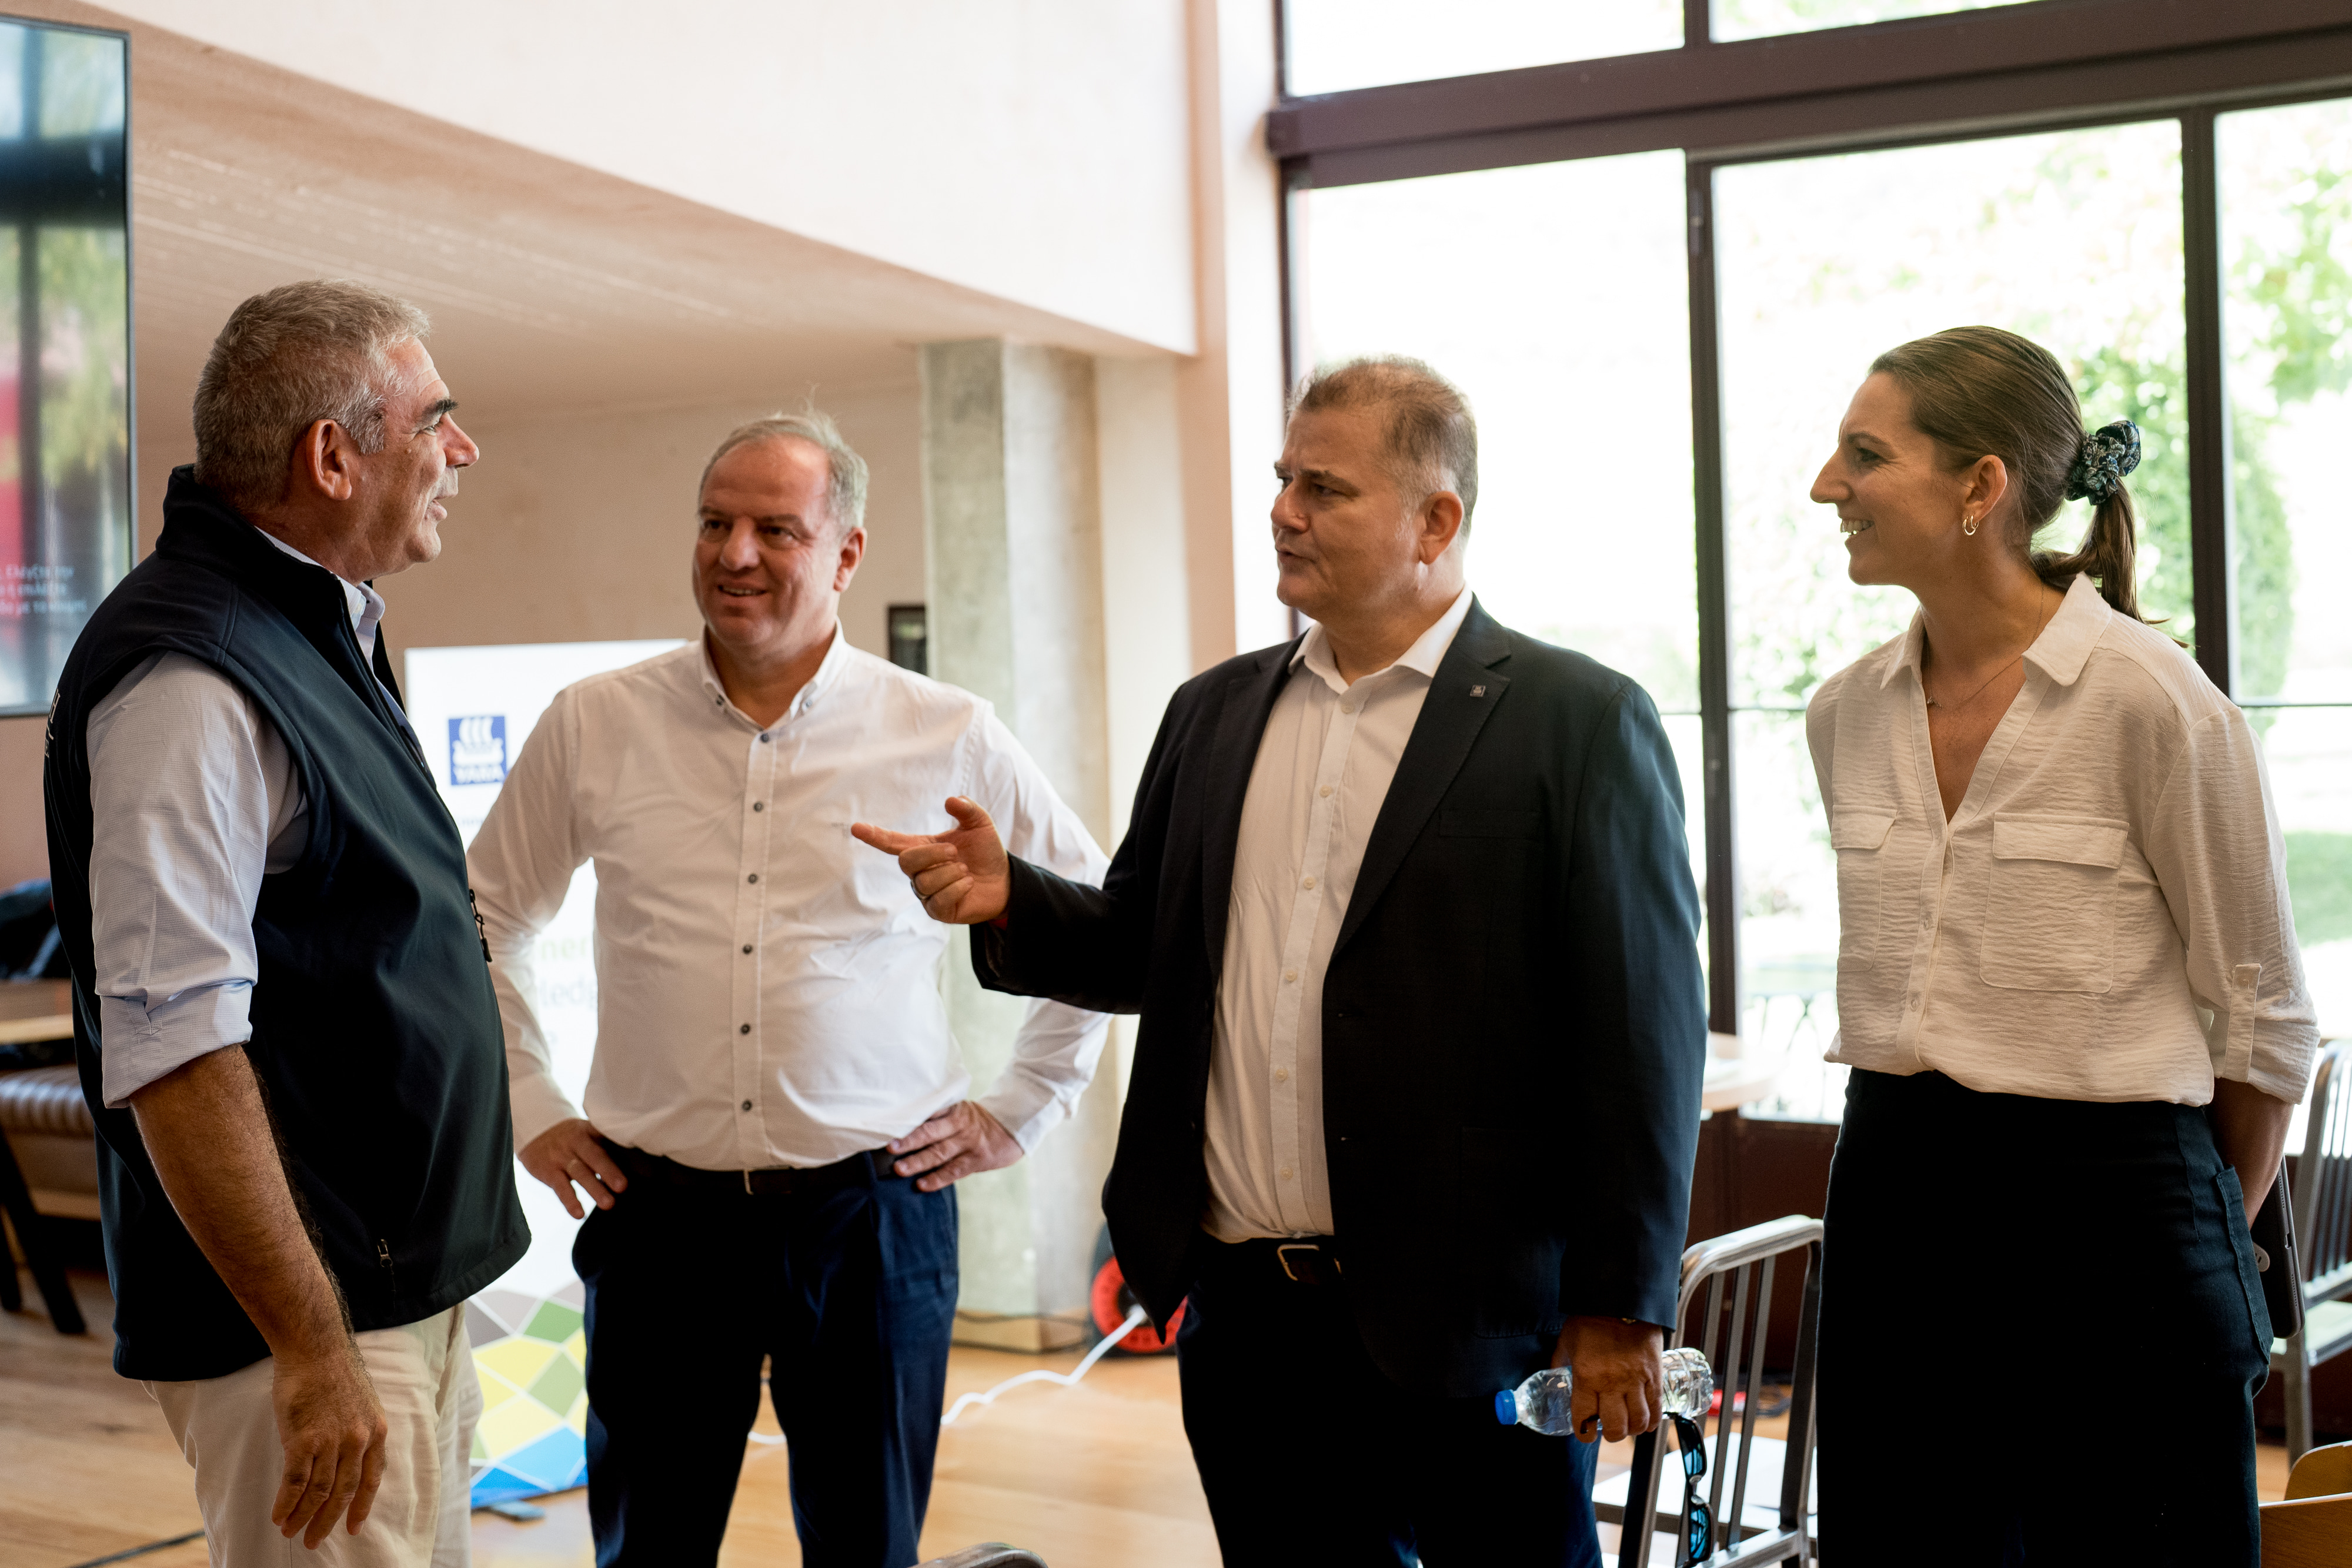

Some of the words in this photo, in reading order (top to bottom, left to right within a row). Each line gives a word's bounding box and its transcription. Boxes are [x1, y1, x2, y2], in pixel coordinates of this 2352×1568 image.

[49, 687, 61, 724] H
[453, 765, 505, 784] YARA
[540, 936, 589, 960] ner
